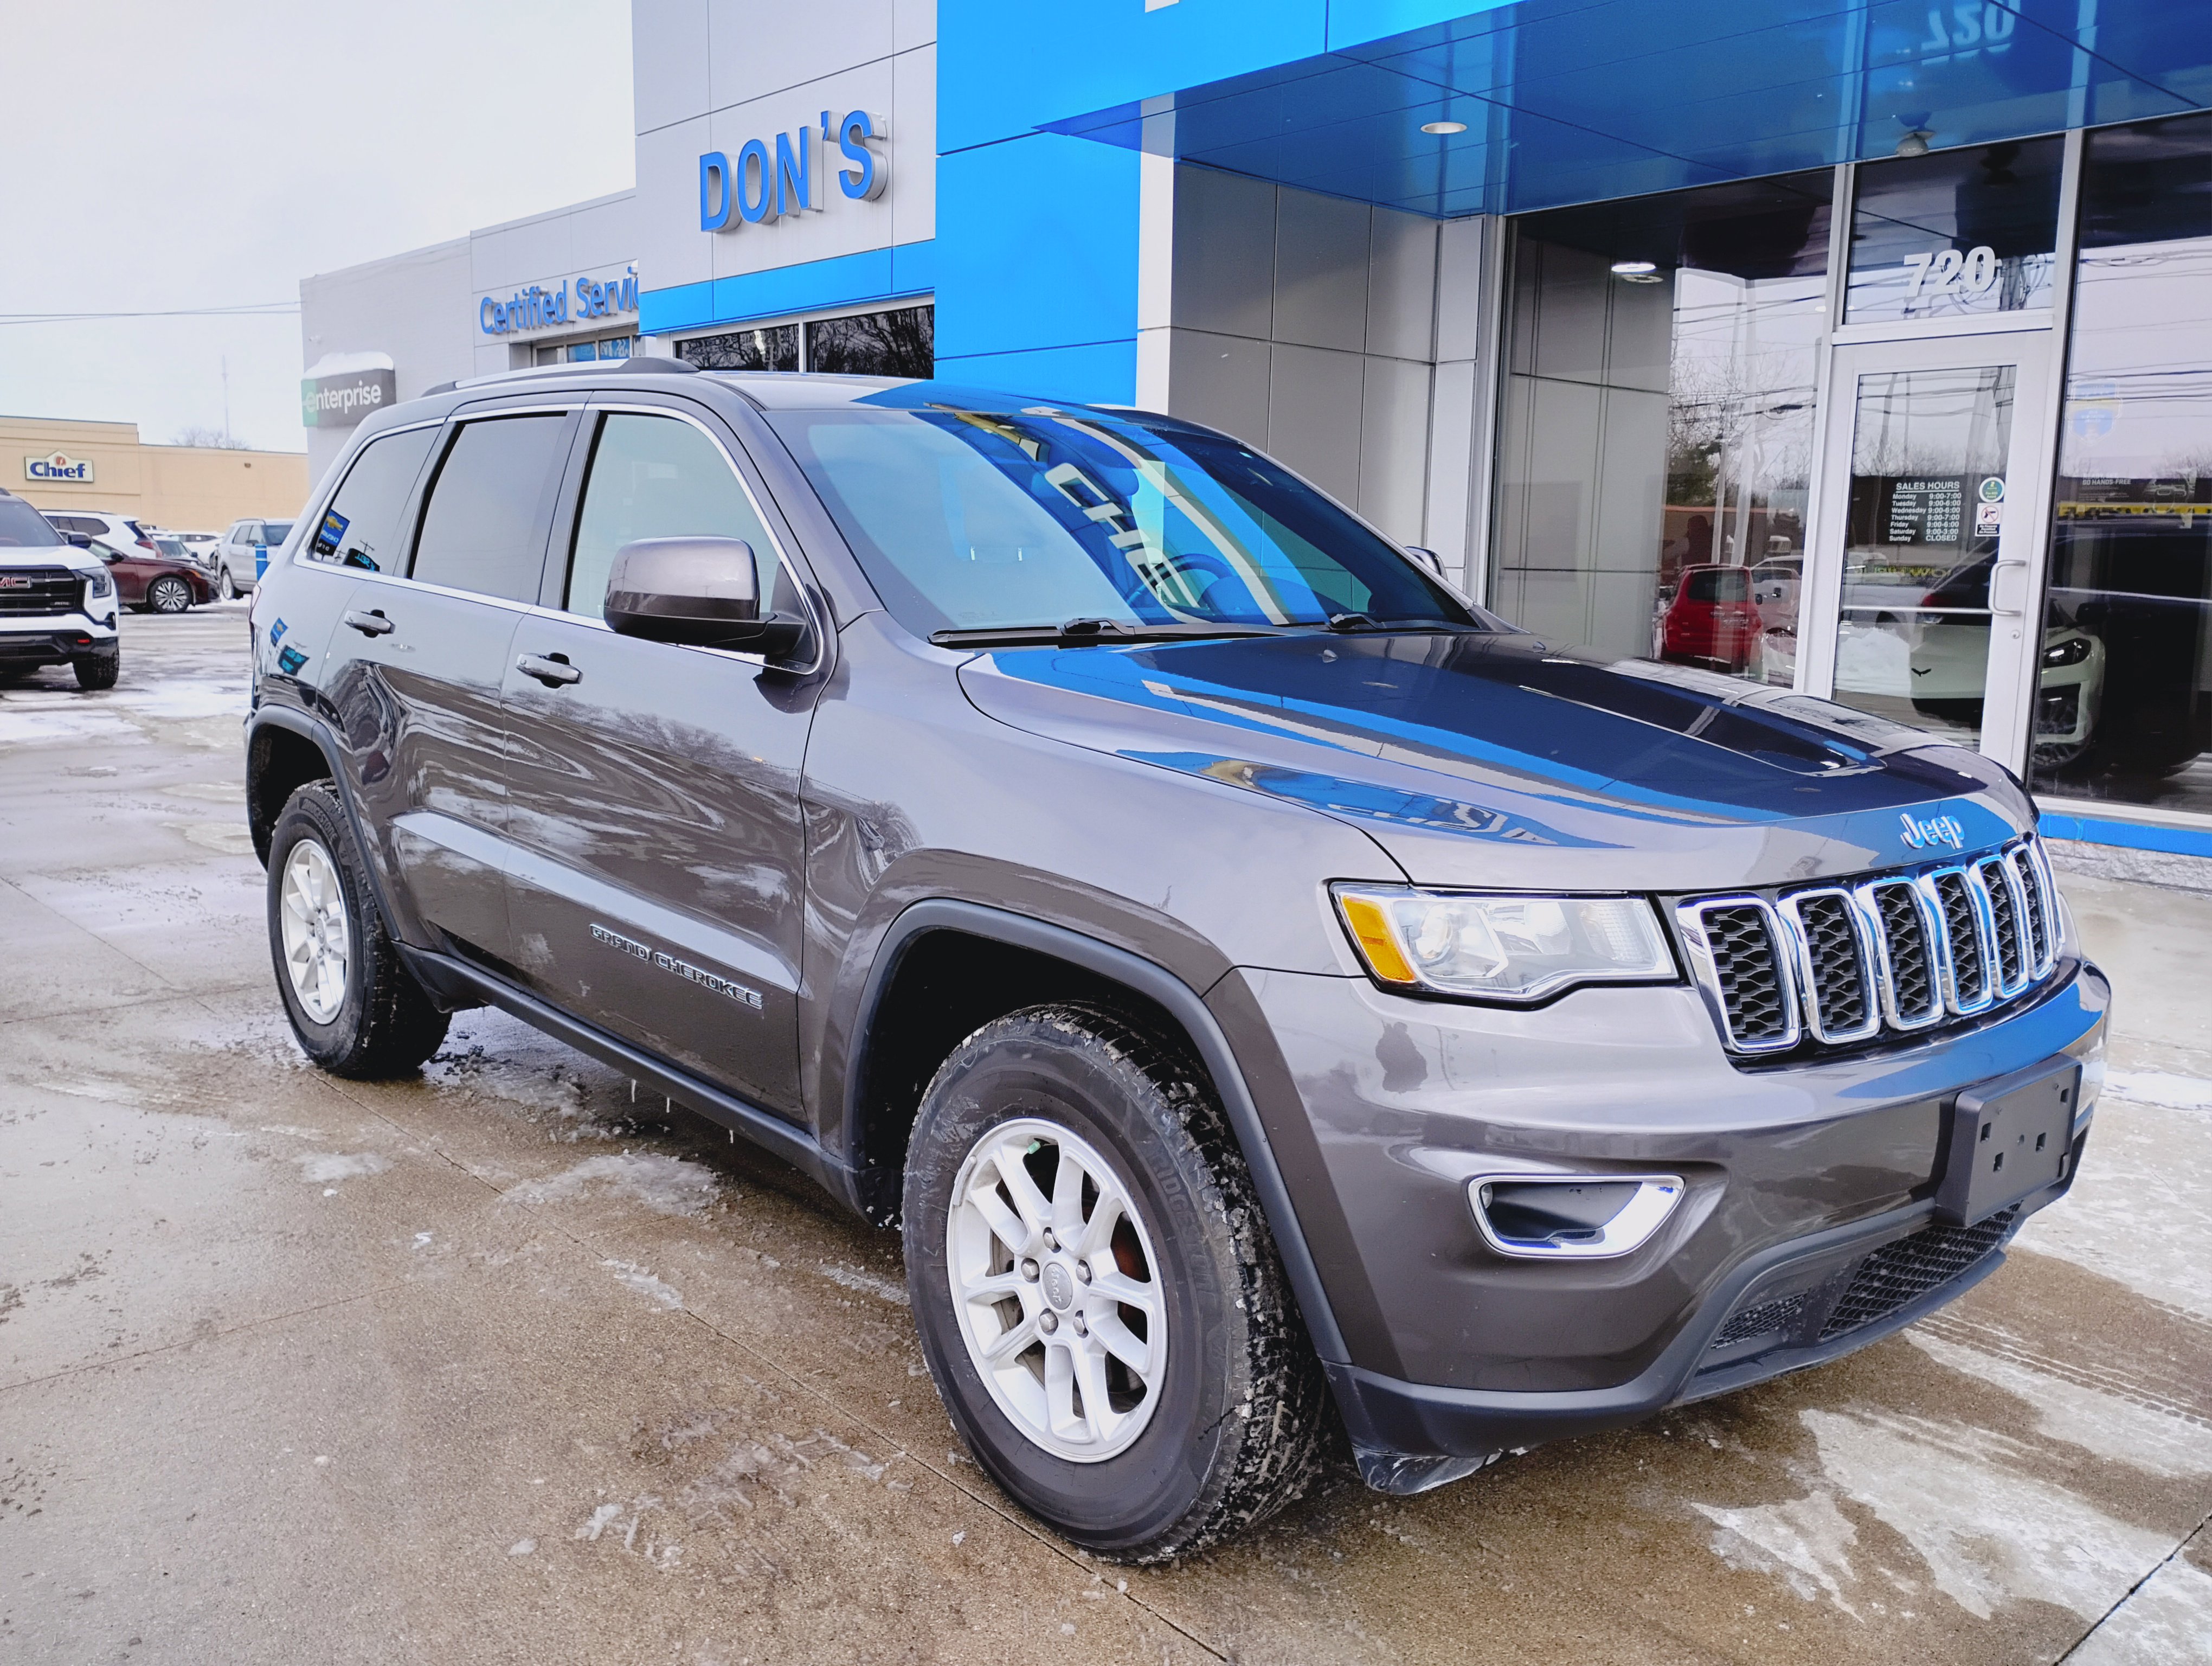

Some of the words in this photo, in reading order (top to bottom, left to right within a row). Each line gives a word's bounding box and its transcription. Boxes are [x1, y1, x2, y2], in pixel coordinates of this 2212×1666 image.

[699, 110, 882, 232] DON'S
[1904, 246, 1996, 298] 720
[480, 279, 568, 335] Certified
[304, 380, 381, 414] enterprise
[30, 462, 85, 478] Chief
[1896, 482, 1925, 490] SALES
[1927, 482, 1960, 490] HOURS
[1900, 813, 1965, 850] Jeep
[589, 924, 652, 962] GRAND
[654, 952, 763, 1010] CHEROKEE
